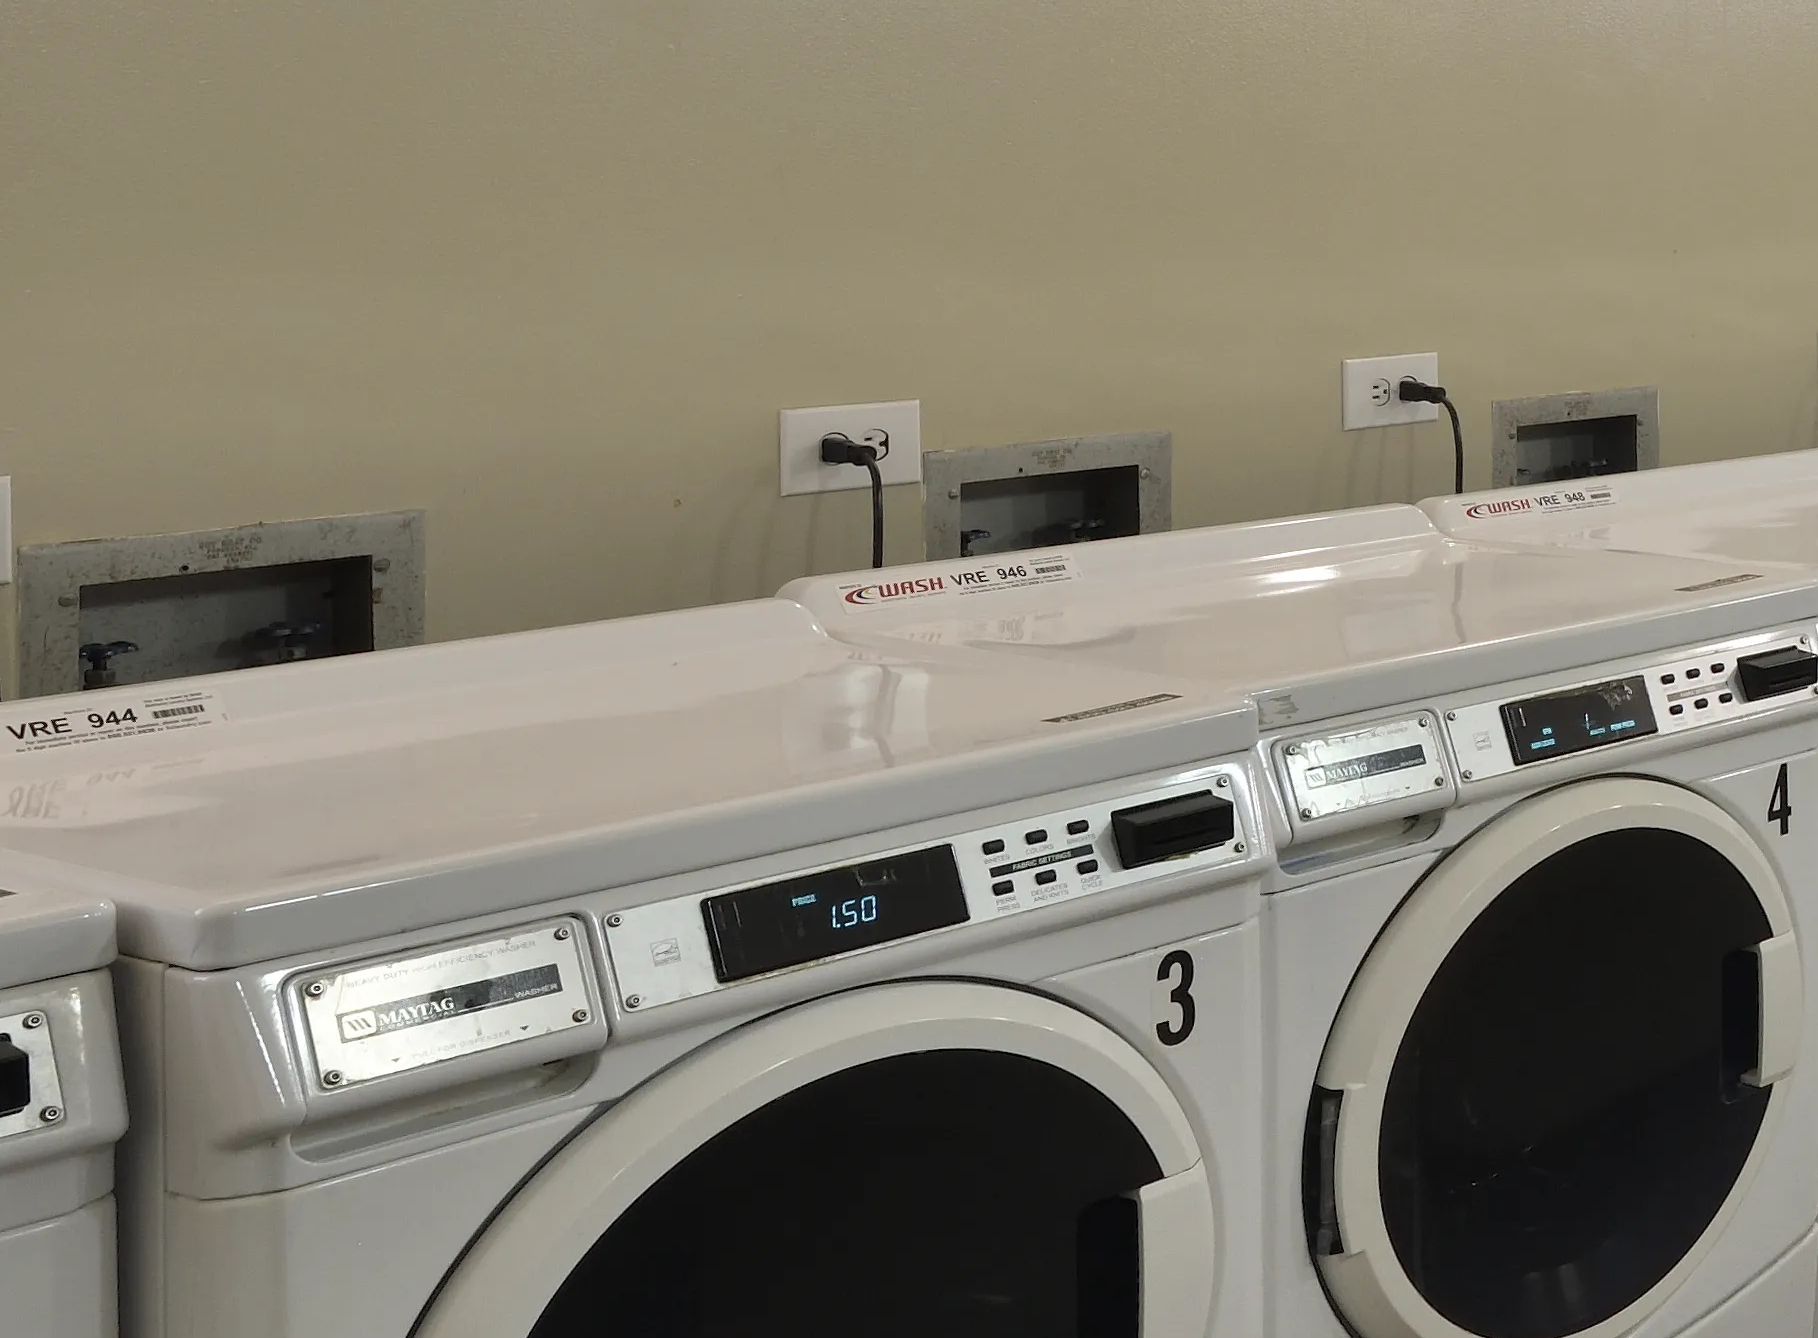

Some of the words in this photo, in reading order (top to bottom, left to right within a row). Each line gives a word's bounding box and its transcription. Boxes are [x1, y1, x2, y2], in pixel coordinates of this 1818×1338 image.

[1533, 494, 1561, 507] VRE
[877, 576, 945, 598] WASH
[950, 570, 990, 586] VRE
[996, 565, 1028, 580] 946
[5, 717, 73, 740] VRE
[87, 708, 138, 728] 944
[1767, 762, 1793, 836] 4
[830, 894, 878, 929] 1.50
[514, 982, 560, 999] WASHER
[1155, 948, 1197, 1047] 3
[378, 996, 456, 1026] MAYTAG
